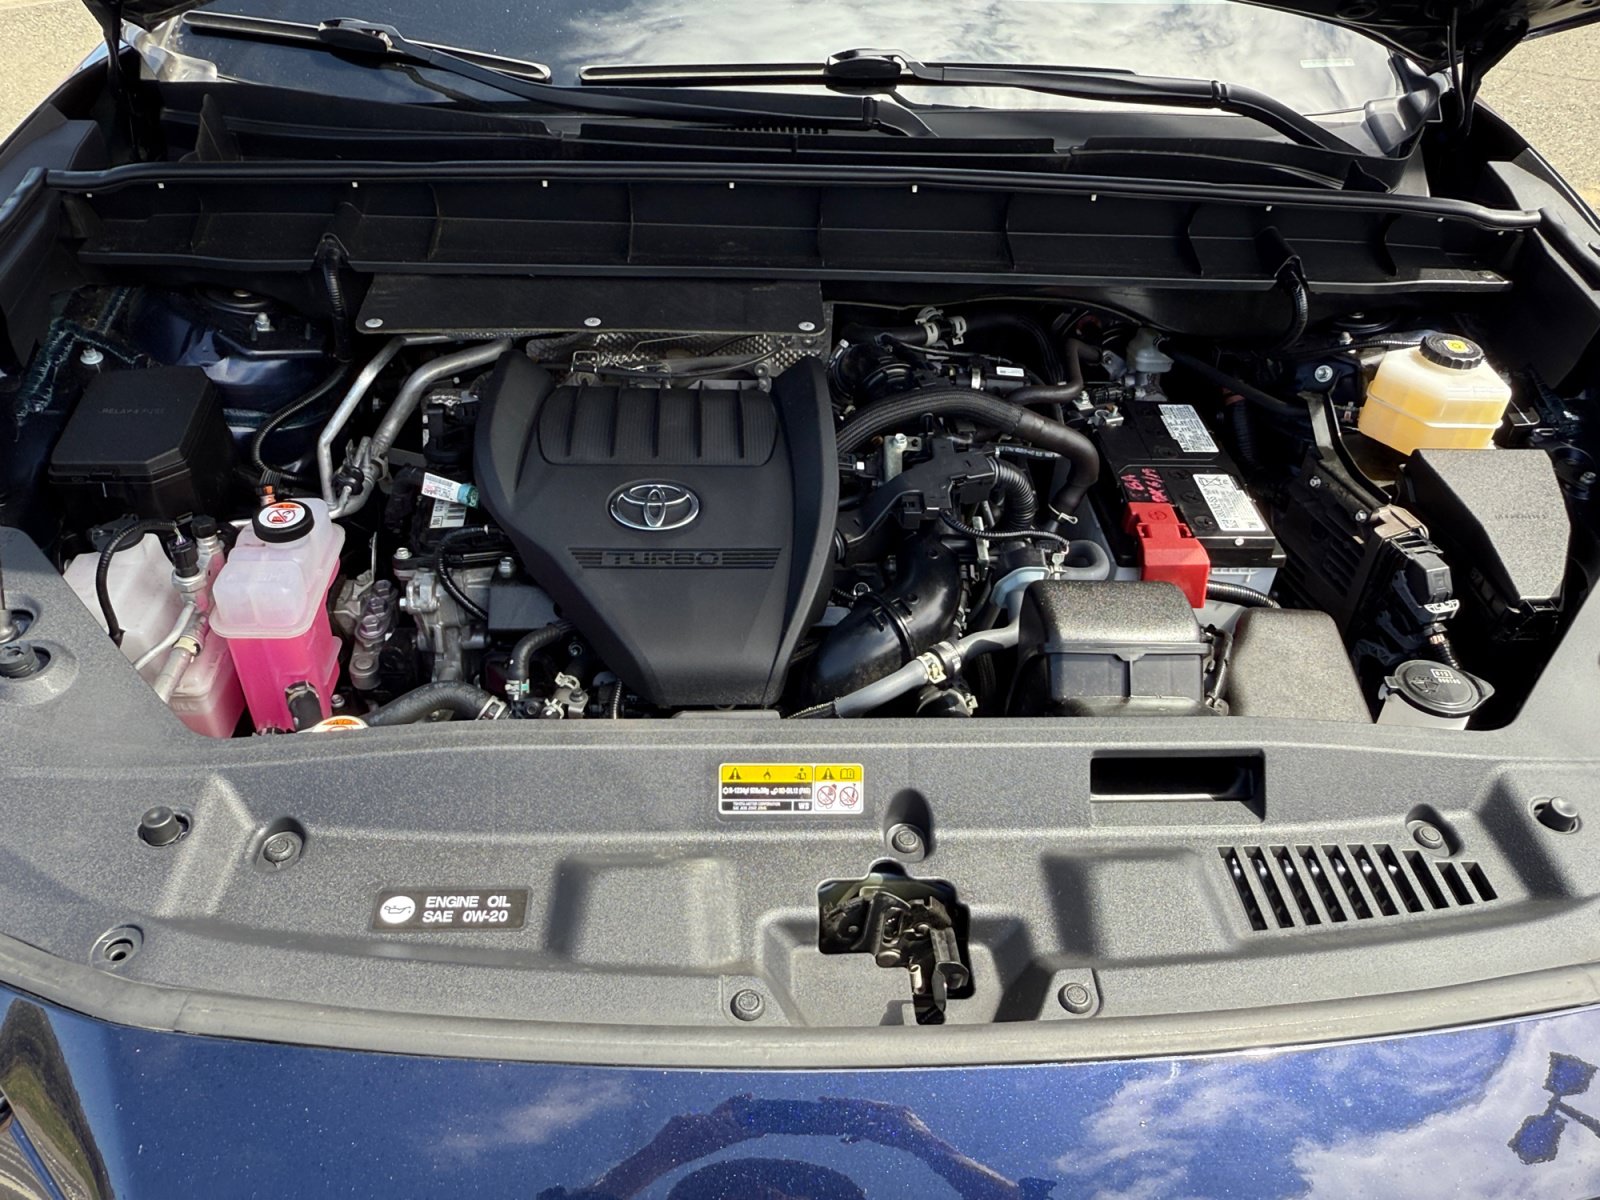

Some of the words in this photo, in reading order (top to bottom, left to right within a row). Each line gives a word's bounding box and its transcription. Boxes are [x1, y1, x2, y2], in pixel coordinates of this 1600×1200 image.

[605, 551, 720, 566] TURBO
[425, 895, 480, 908] ENGINE
[487, 895, 511, 908] OIL
[422, 910, 454, 923] SAE
[462, 910, 508, 922] 0W-20
